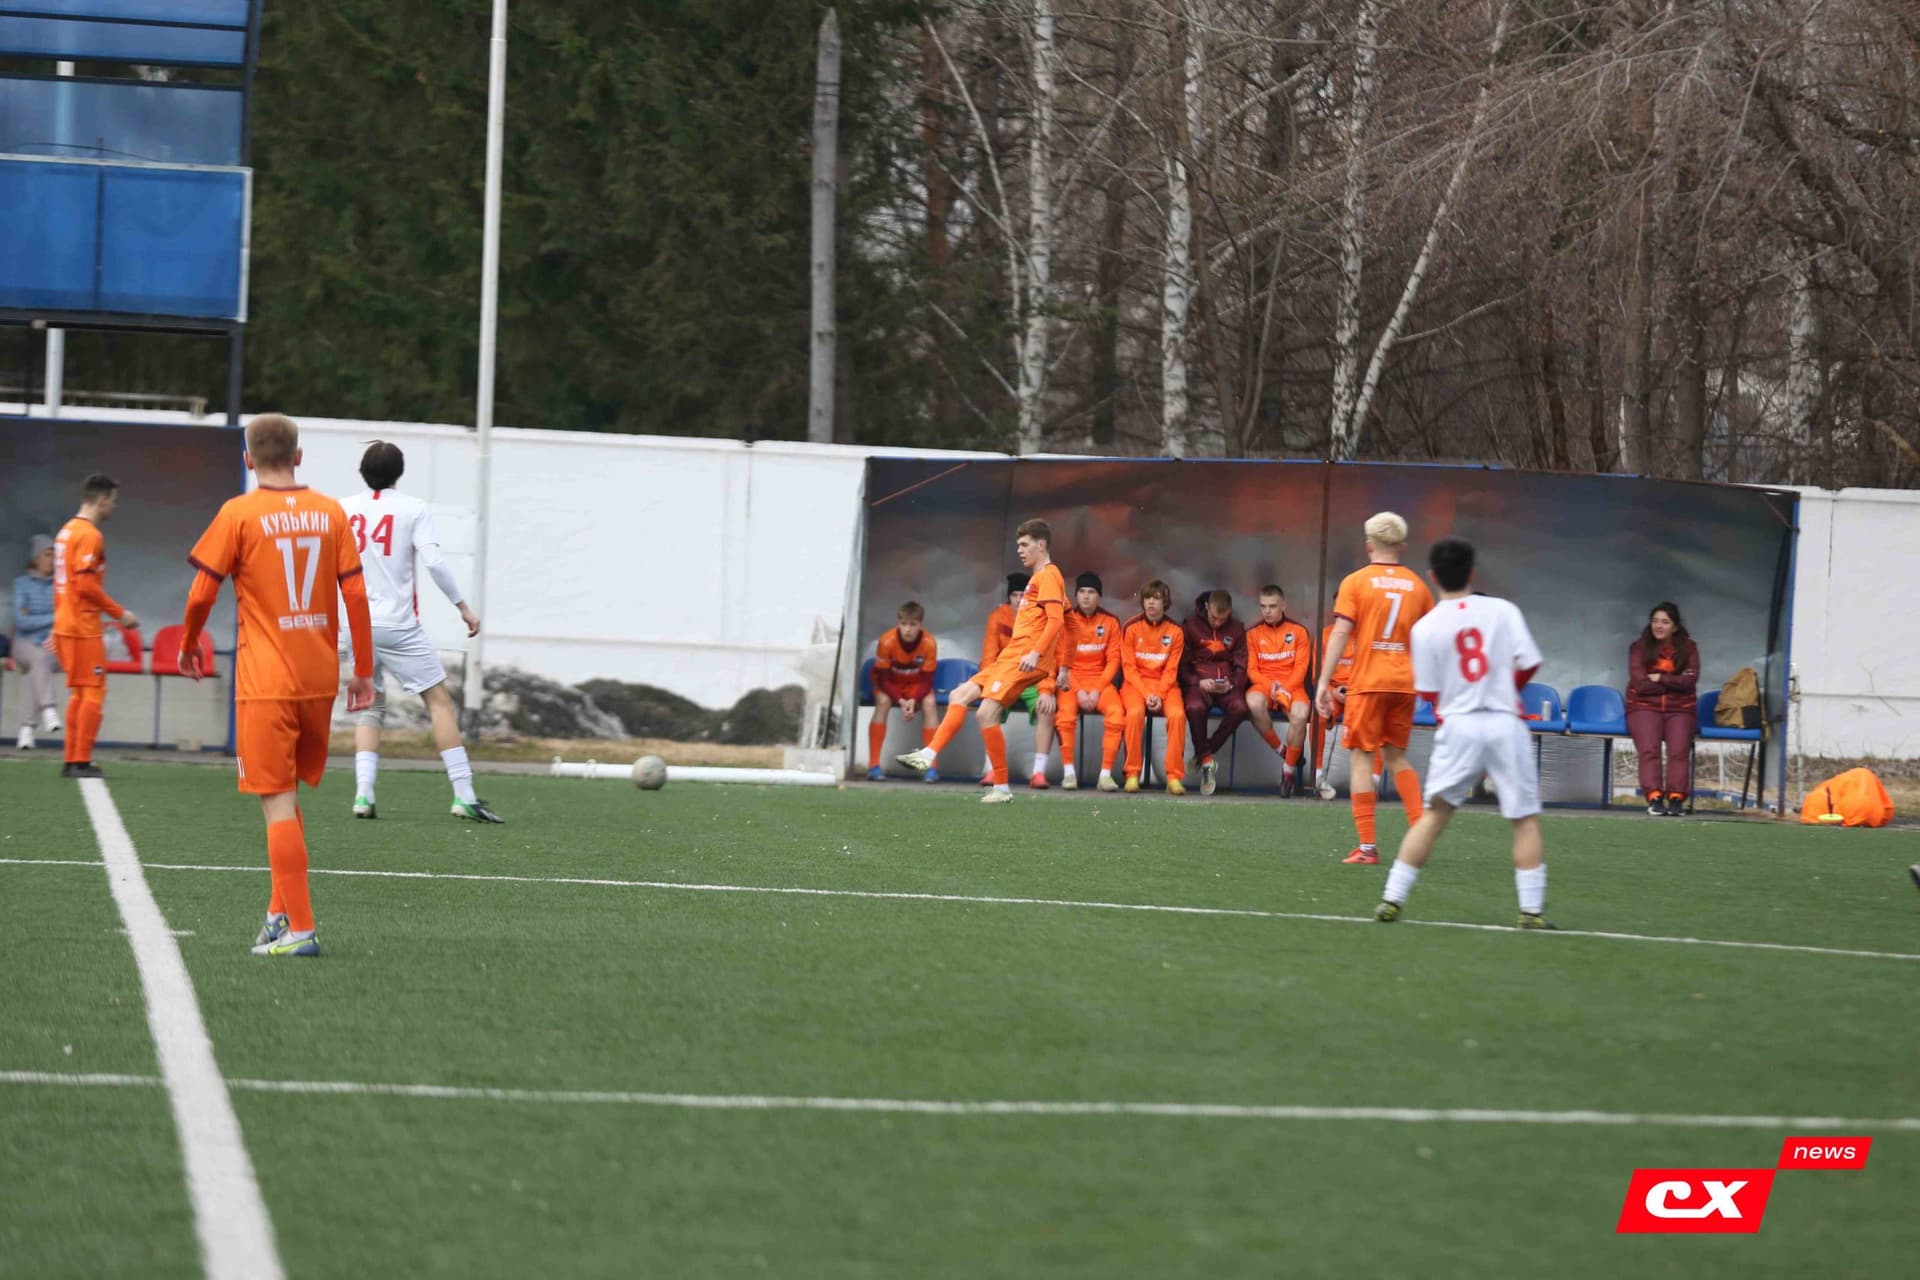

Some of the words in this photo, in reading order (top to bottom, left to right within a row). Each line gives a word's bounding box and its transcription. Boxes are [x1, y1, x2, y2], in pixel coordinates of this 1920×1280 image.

[260, 511, 329, 537] КУЗЬКИН
[350, 513, 394, 556] 34
[276, 537, 321, 612] 17
[1383, 592, 1403, 639] 7
[1456, 627, 1488, 683] 8
